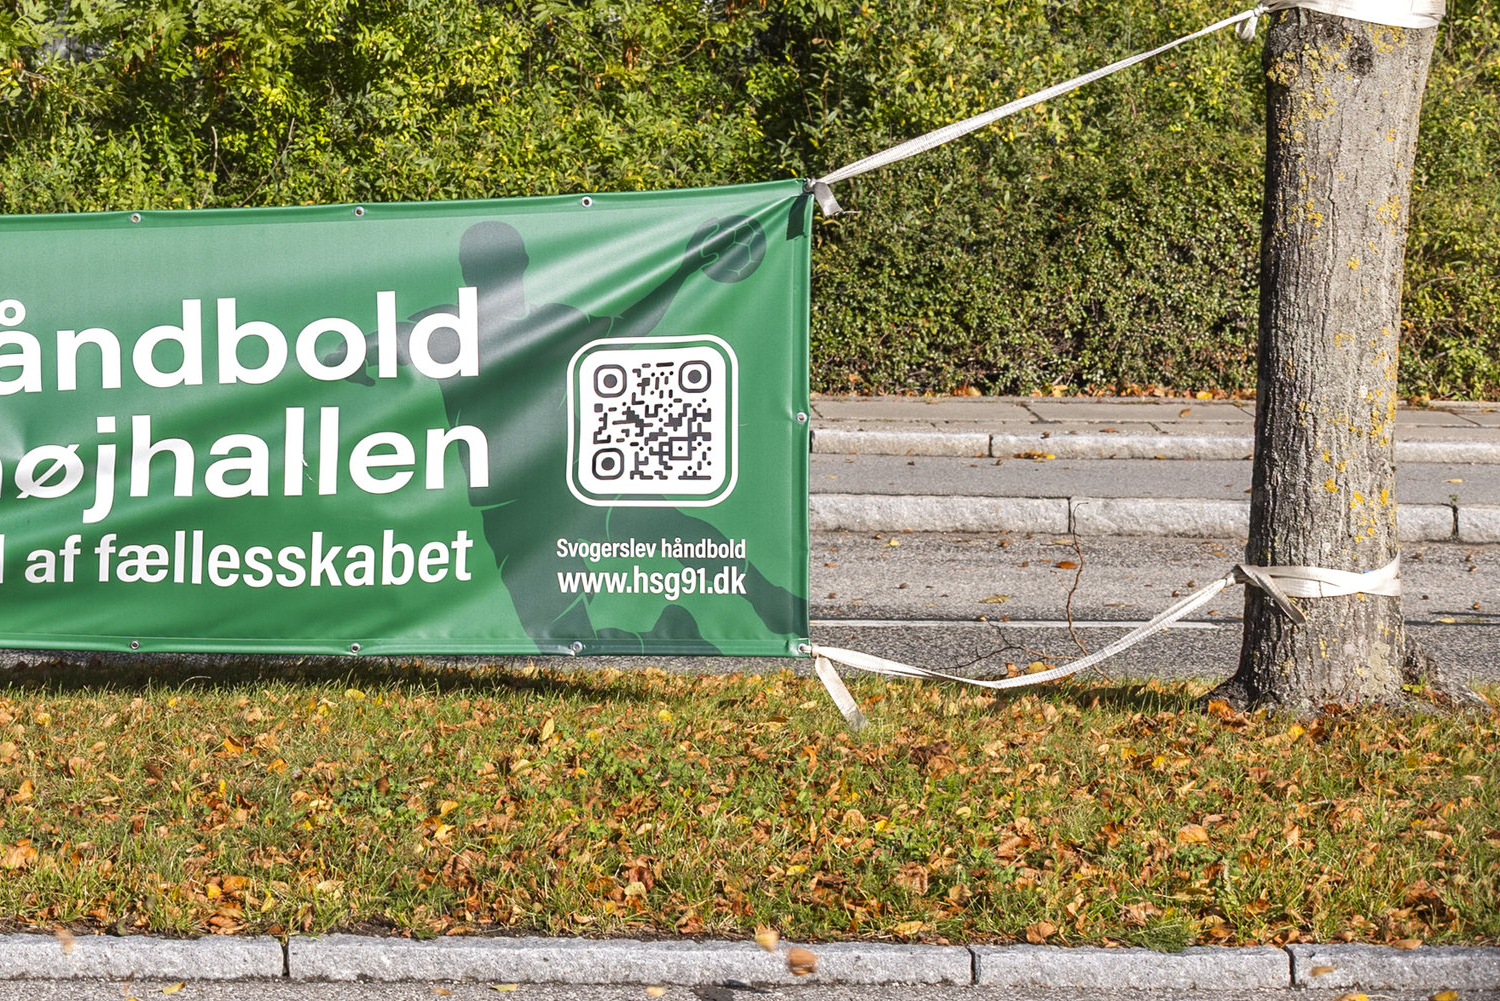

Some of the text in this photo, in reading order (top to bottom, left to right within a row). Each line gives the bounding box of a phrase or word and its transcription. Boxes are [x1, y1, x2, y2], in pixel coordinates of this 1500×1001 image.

[24, 534, 84, 584] af
[93, 529, 474, 588] fællesskabet
[556, 537, 747, 563] Svogerslev håndbold
[556, 564, 748, 601] www.hsg91.dk
